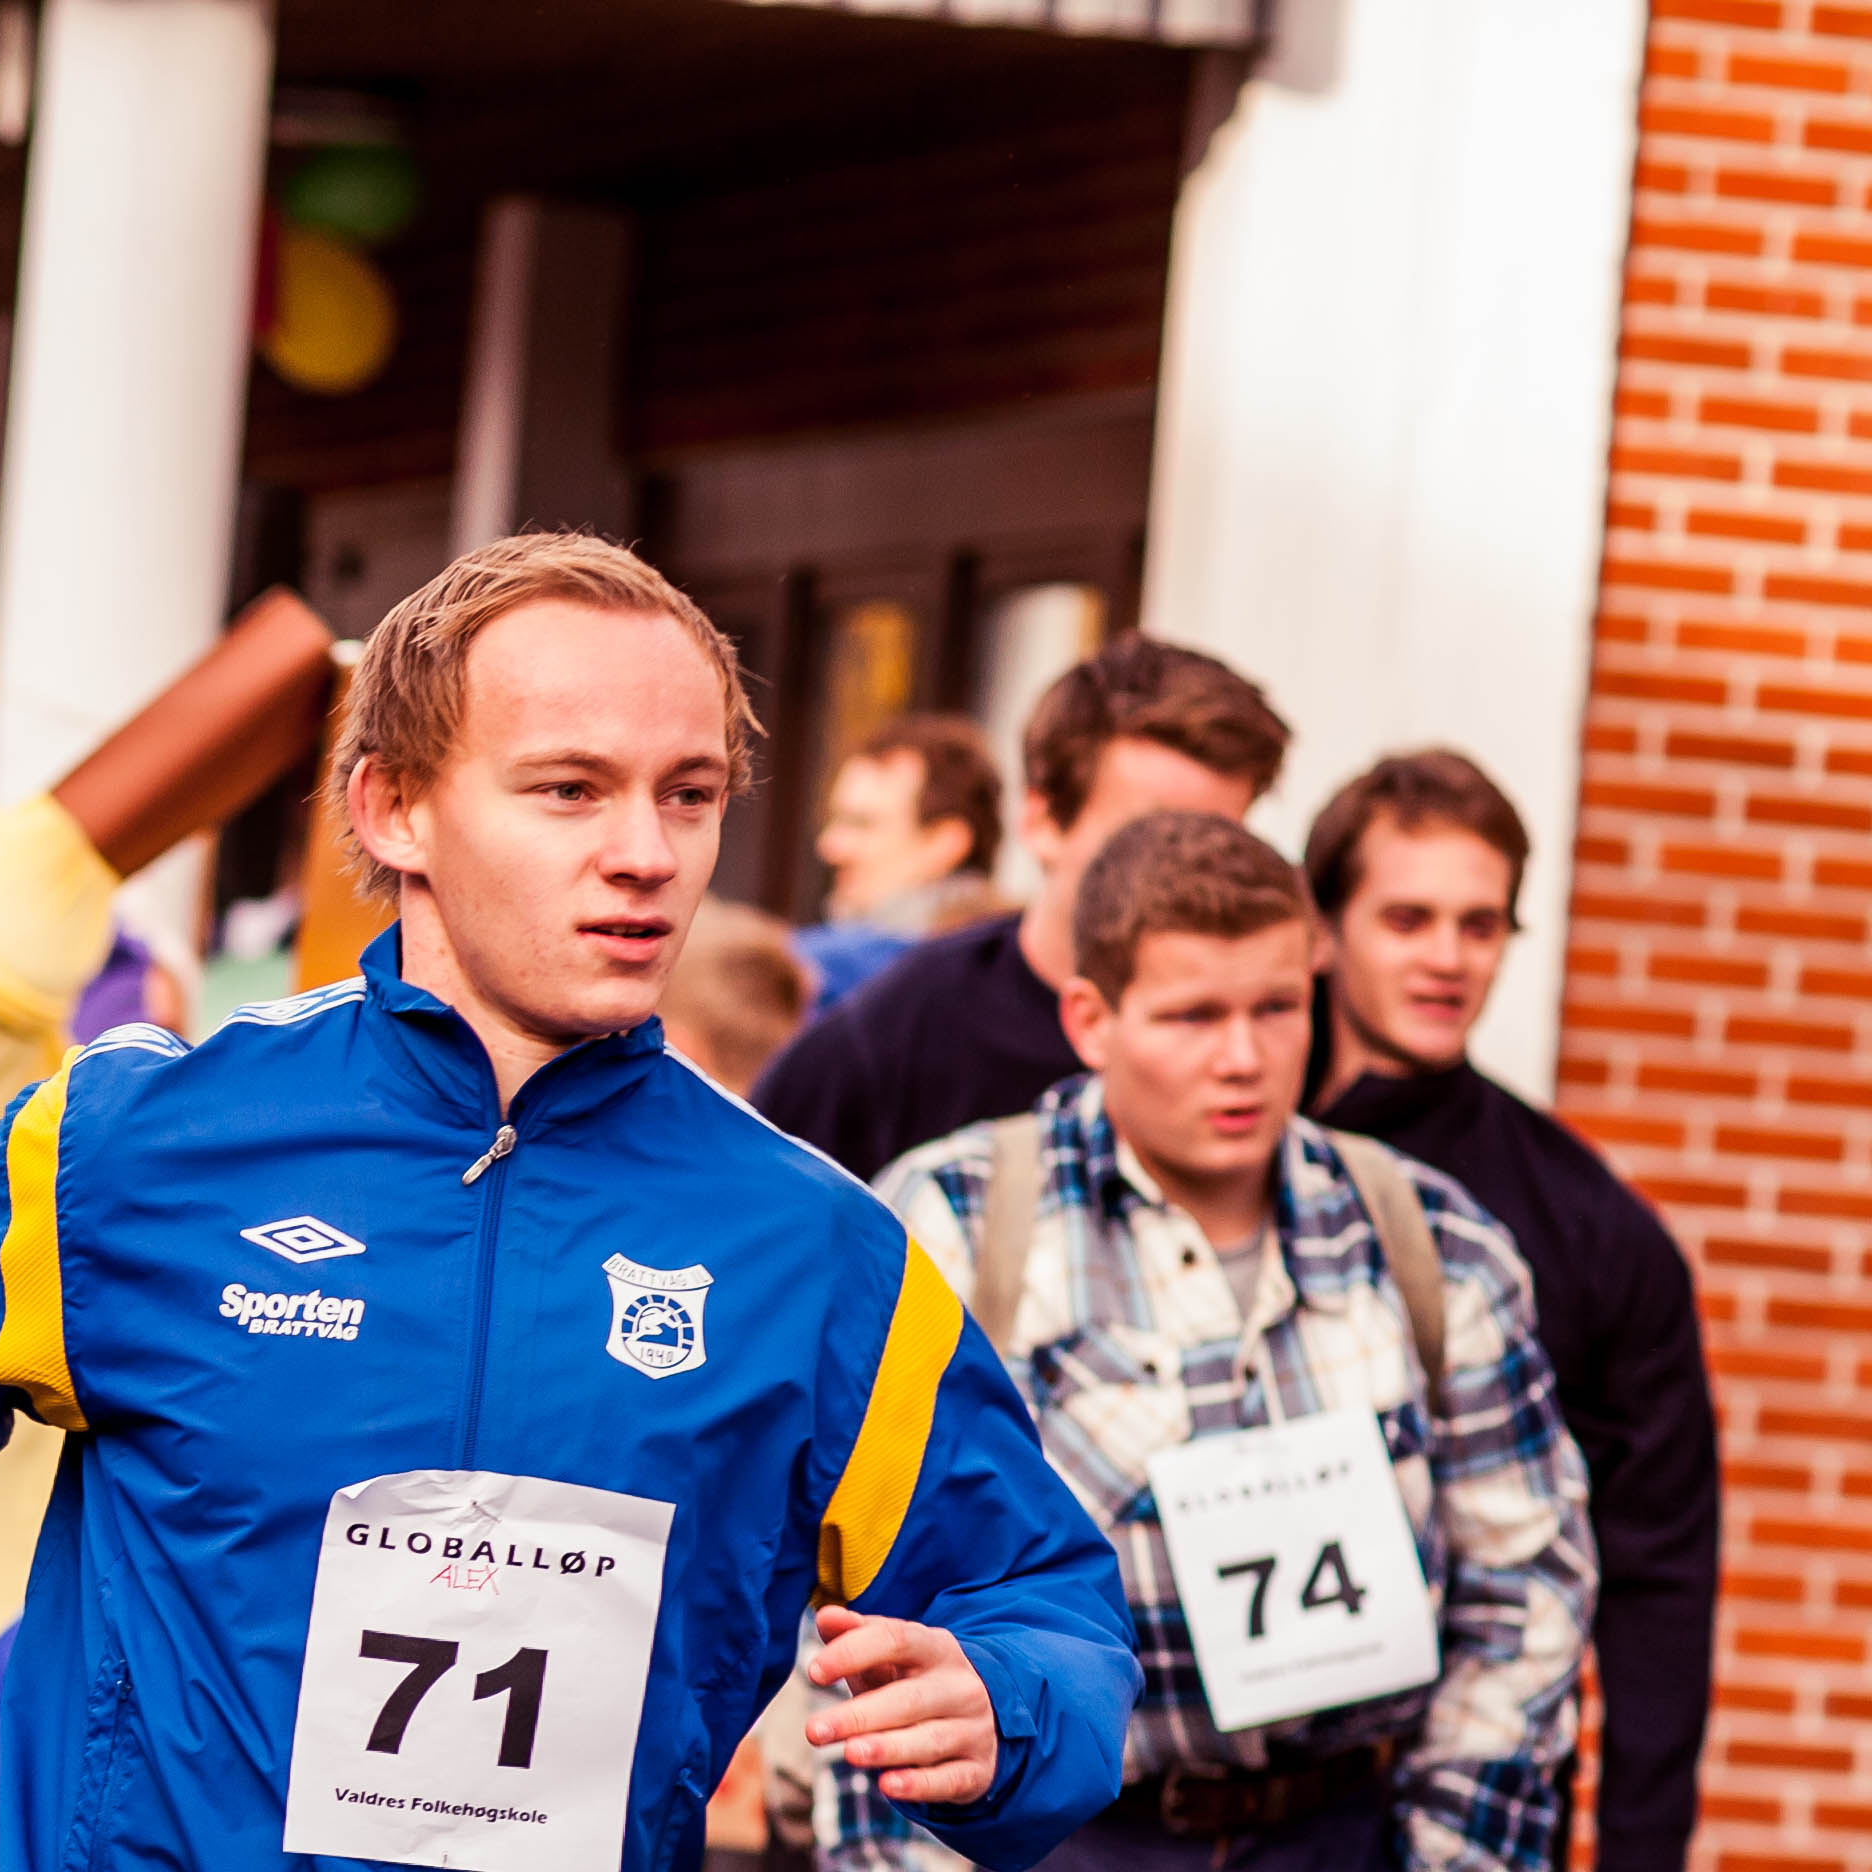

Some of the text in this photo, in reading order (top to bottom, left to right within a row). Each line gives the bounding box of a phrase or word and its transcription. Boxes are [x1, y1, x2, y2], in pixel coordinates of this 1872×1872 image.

[218, 1283, 366, 1326] Sporten
[248, 1318, 360, 1342] BRATTVÅG
[640, 1347, 674, 1364] 1940
[346, 1522, 616, 1578] GLOBALLØP
[429, 1563, 500, 1596] ALEX
[1217, 1540, 1367, 1639] 74
[359, 1629, 548, 1768] 71
[334, 1787, 548, 1825] Valdres Folkehøgskole
